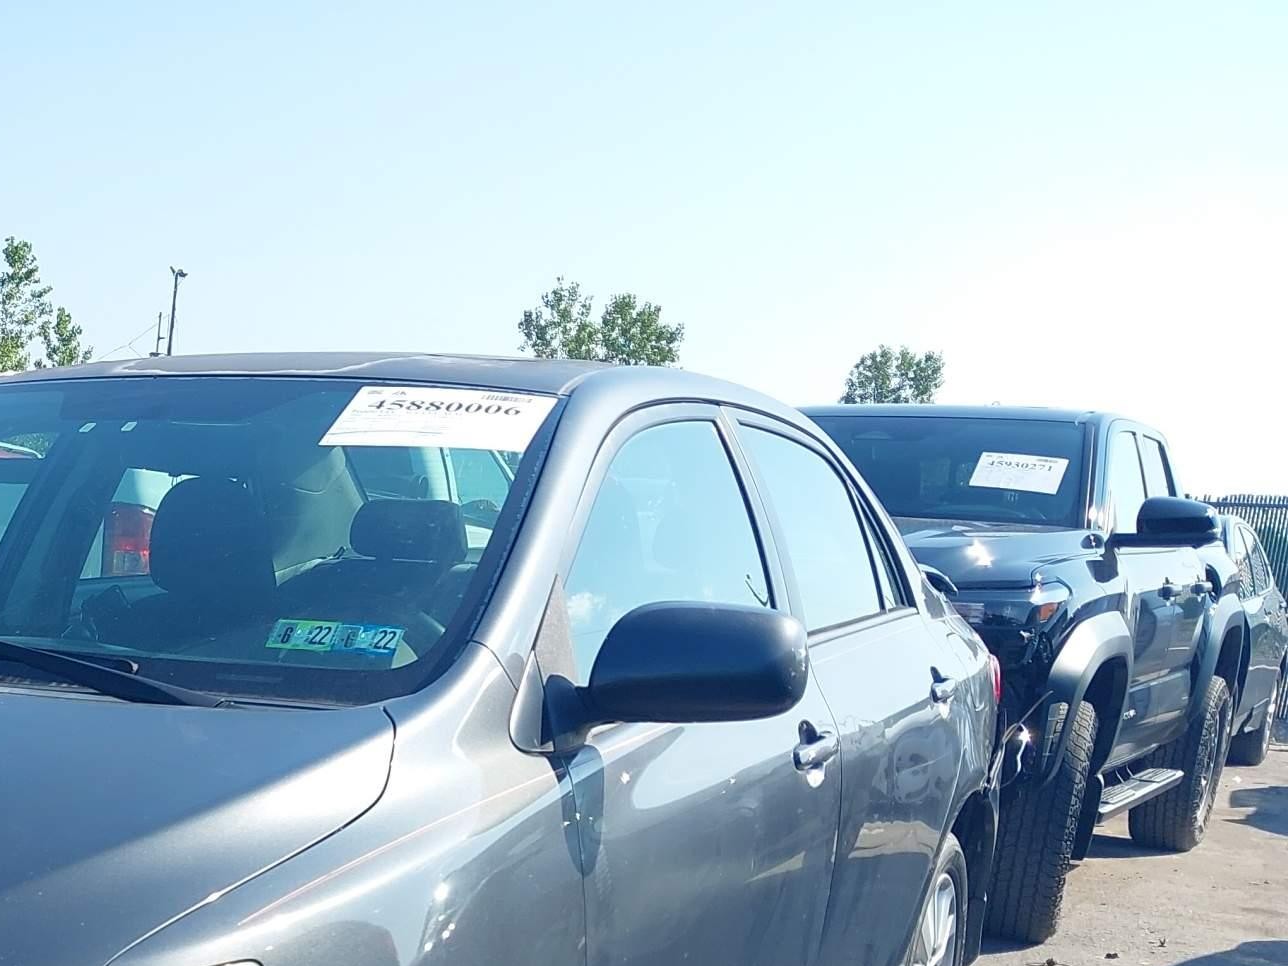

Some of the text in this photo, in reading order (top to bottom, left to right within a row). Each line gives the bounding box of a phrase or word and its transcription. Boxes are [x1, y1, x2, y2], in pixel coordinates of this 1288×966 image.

[368, 398, 521, 416] 45880006
[308, 625, 332, 645] 22
[373, 629, 397, 649] 22
